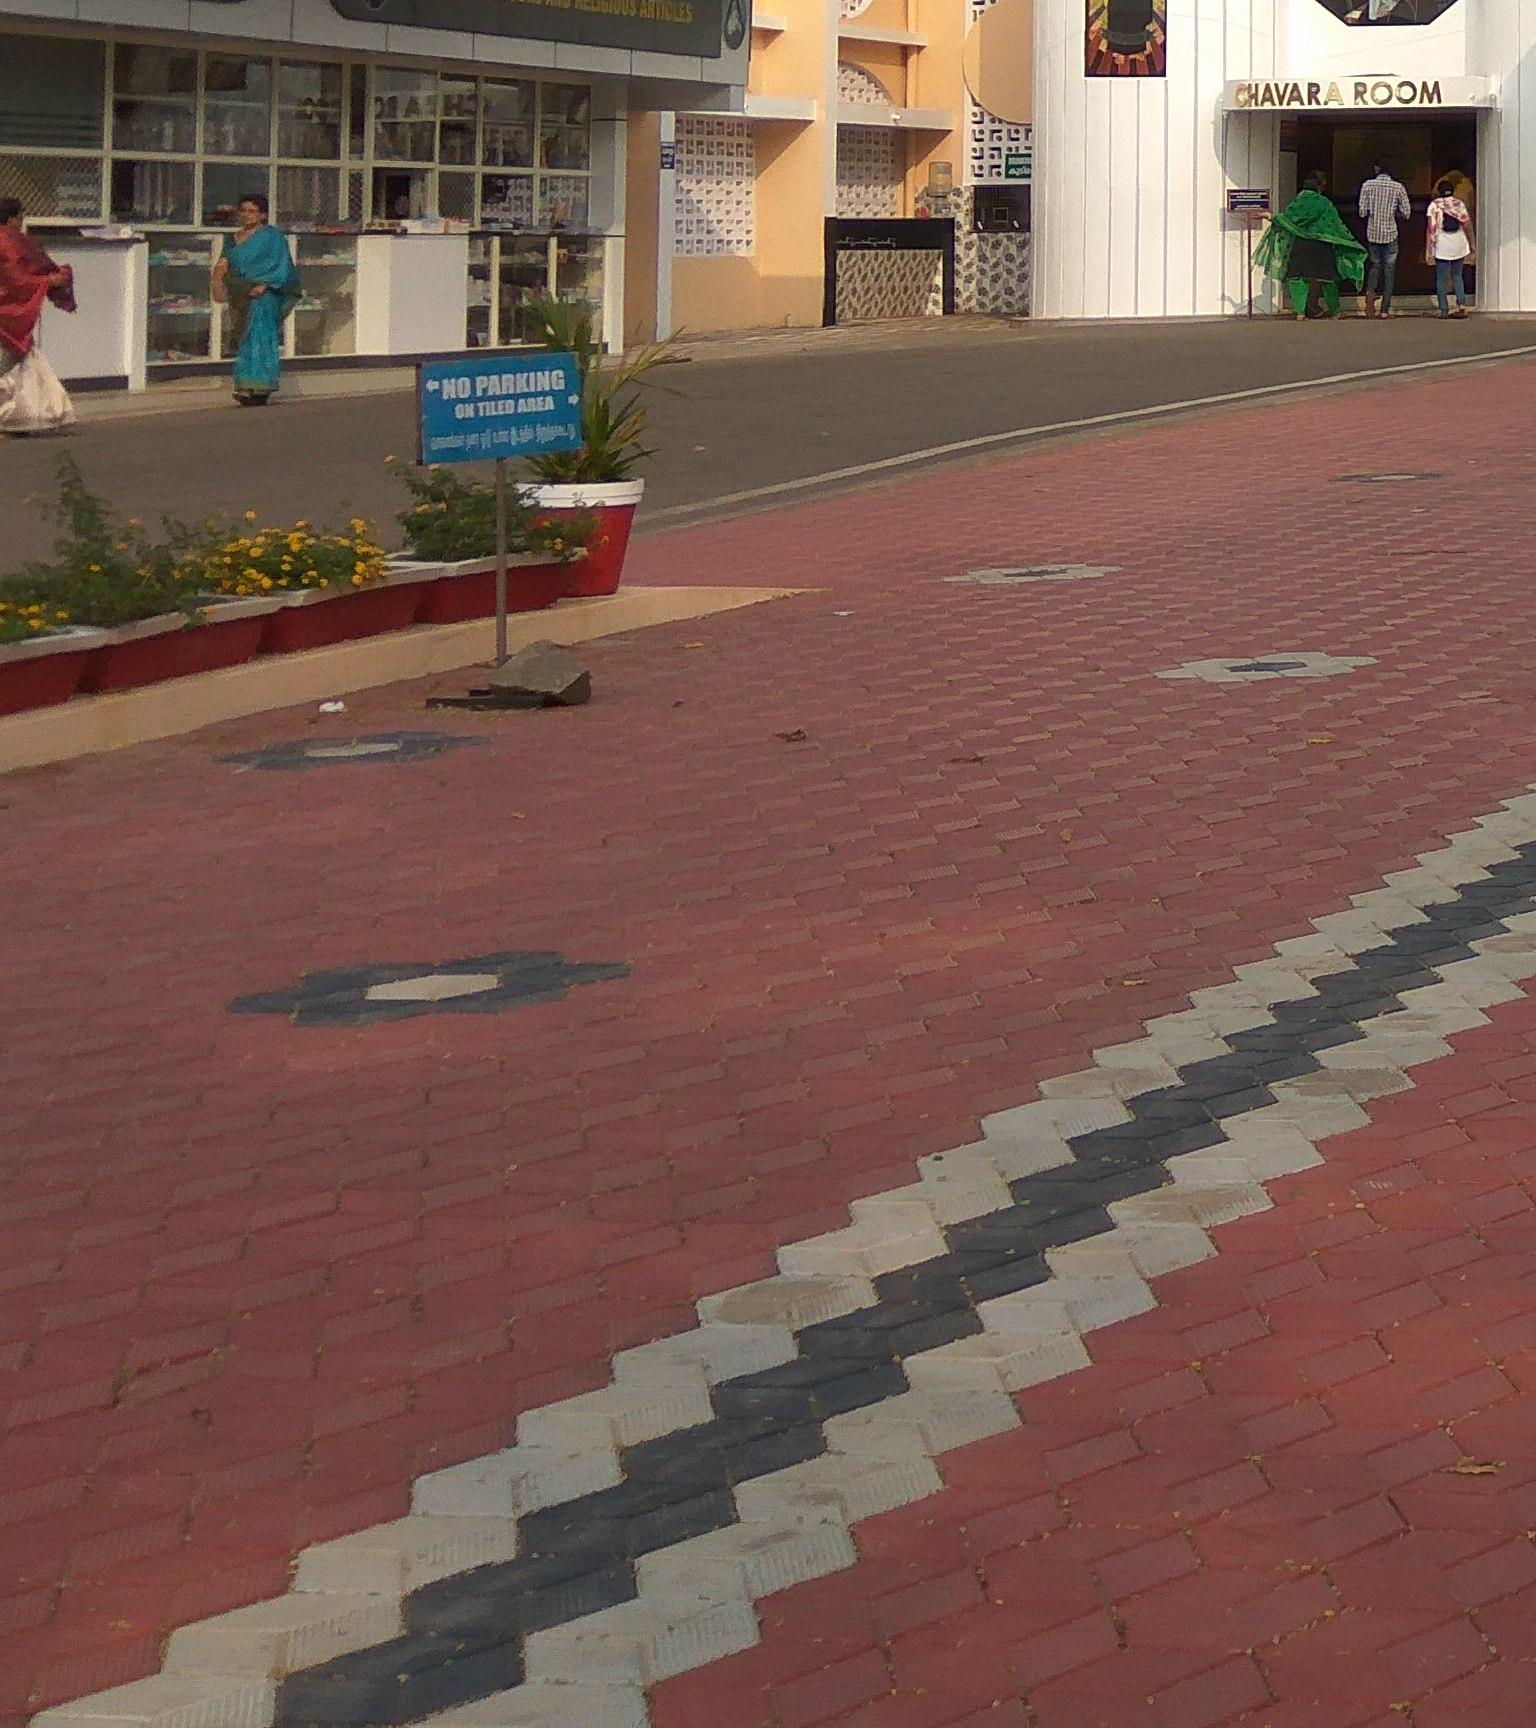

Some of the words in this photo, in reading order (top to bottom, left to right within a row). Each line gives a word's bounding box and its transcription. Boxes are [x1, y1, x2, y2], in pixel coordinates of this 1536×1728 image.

[1234, 81, 1344, 108] CHAVARA
[1354, 80, 1443, 106] ROOM
[441, 376, 472, 400] NO
[475, 369, 566, 398] PARKING
[454, 403, 475, 420] ON
[476, 399, 516, 417] TILED
[516, 395, 556, 413] AREA
